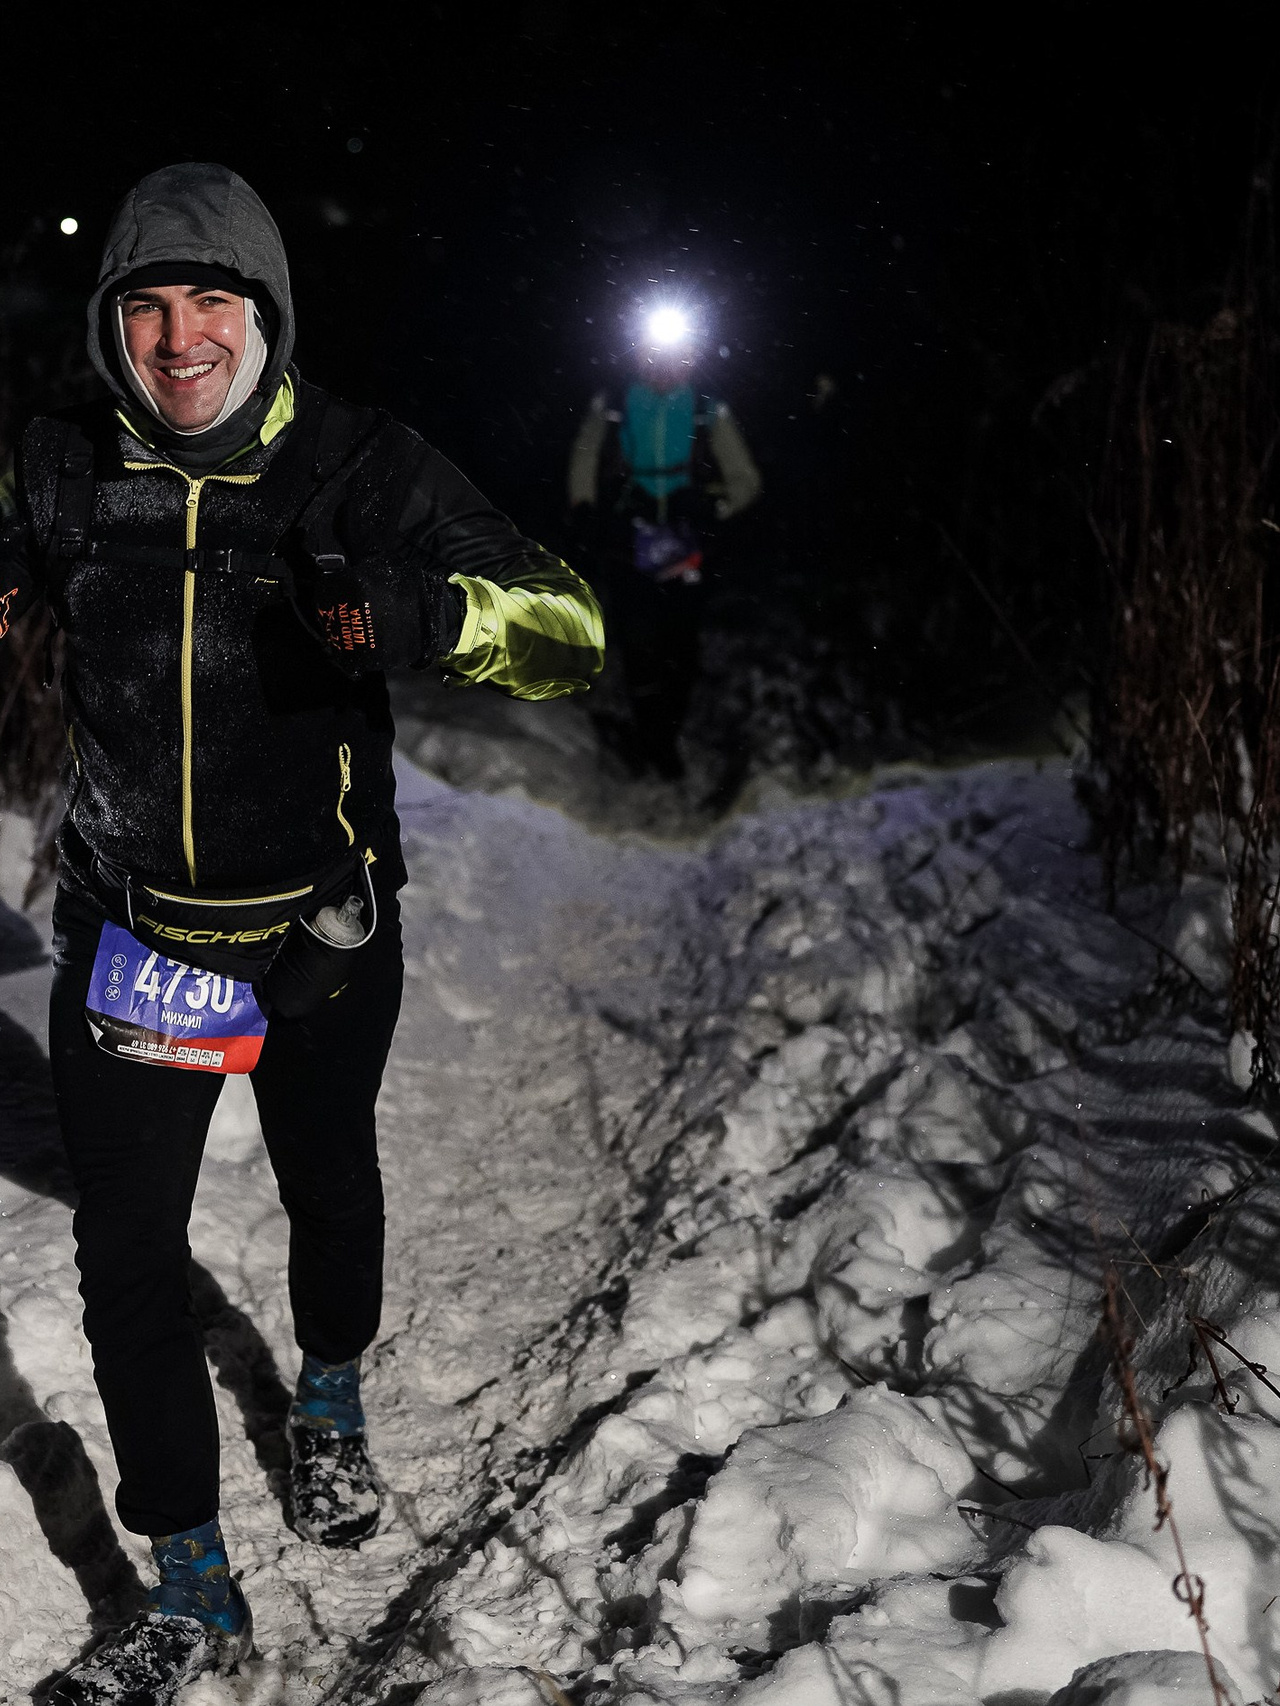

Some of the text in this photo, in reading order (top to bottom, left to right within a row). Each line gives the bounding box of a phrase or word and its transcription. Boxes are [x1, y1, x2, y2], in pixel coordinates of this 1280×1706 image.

[341, 626, 354, 650] MAD
[349, 608, 366, 644] ULTRA
[136, 914, 291, 944] FISCHER
[134, 950, 235, 1014] 4730
[160, 1009, 202, 1030] МИХАИЛ
